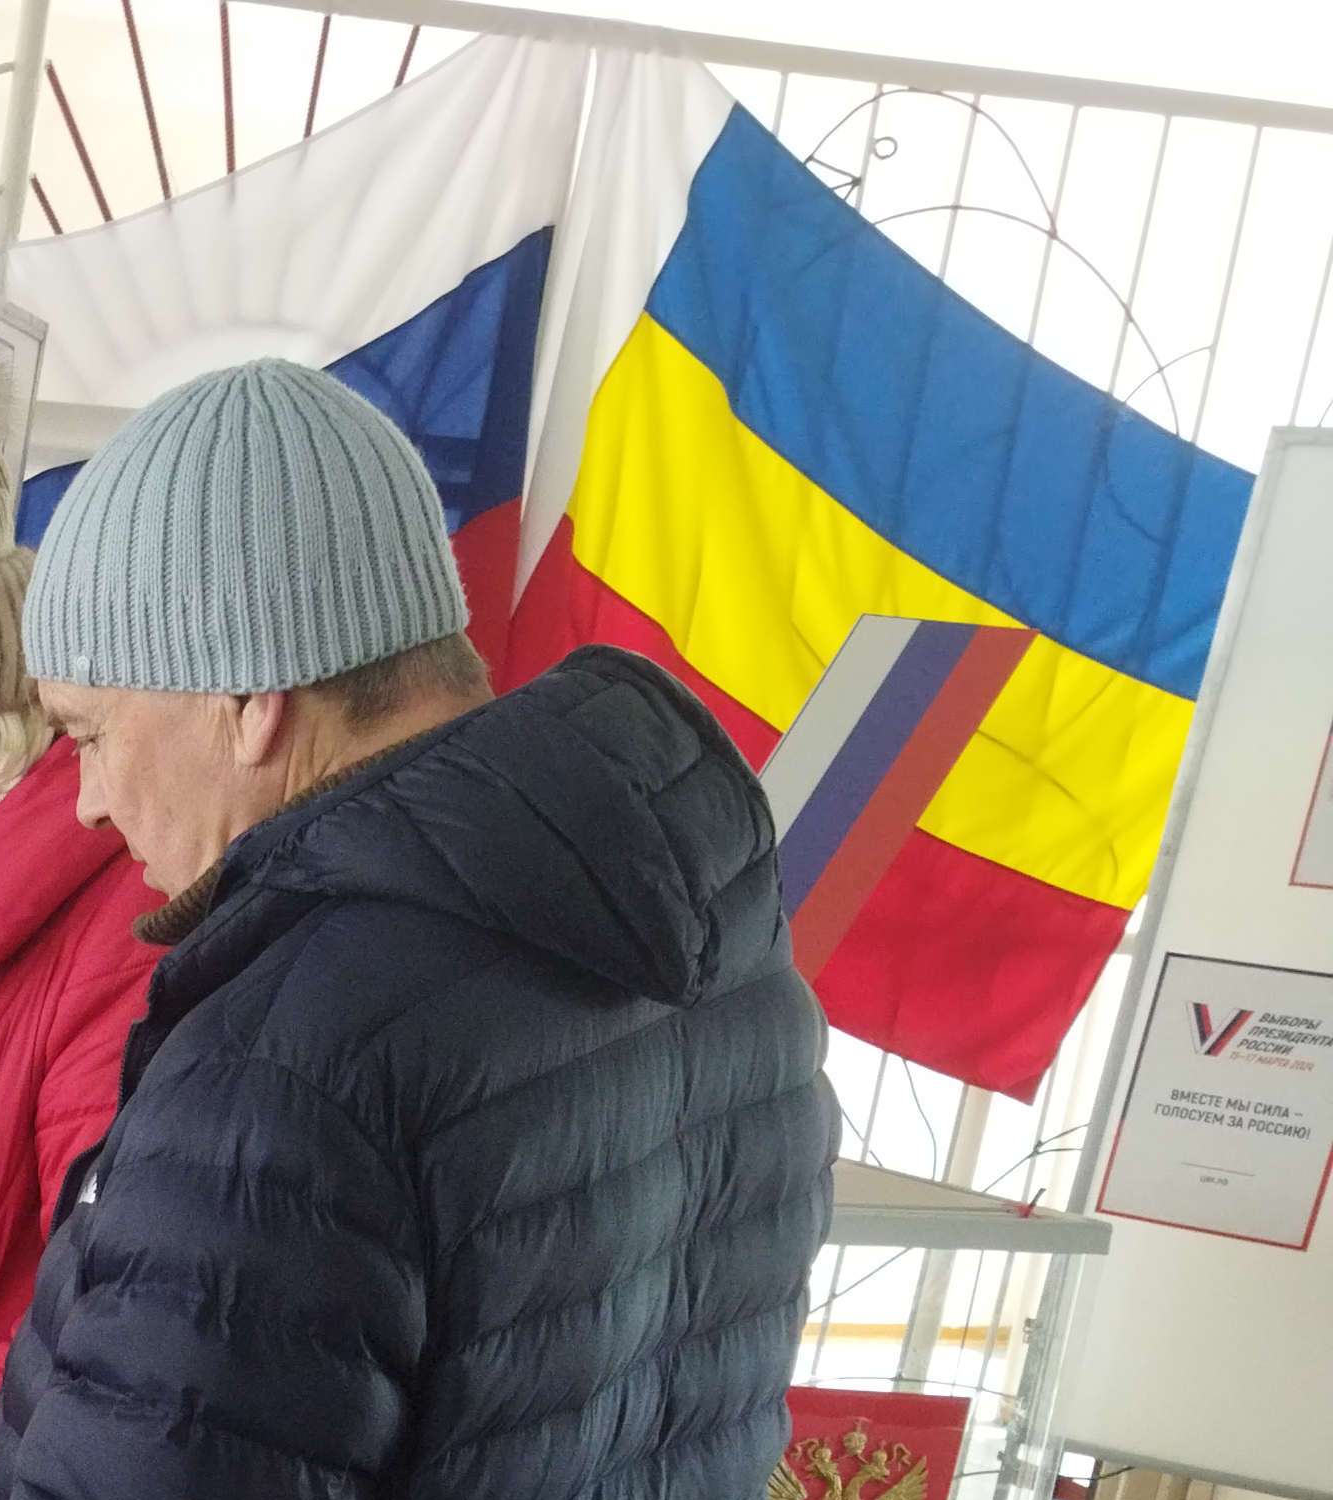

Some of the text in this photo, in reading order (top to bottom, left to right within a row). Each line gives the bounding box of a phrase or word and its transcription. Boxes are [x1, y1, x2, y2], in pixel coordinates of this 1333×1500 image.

[1259, 1012, 1322, 1030] ВЫБОРЫ
[1238, 1038, 1295, 1055] РОССИИ
[1170, 1089, 1223, 1108] ВМЕСТЕ
[1225, 1098, 1251, 1112] МЫ
[1254, 1103, 1290, 1118] СИЛА
[1154, 1103, 1311, 1140] ГОЛОСУЕМ ЗА РОССИЮ!
